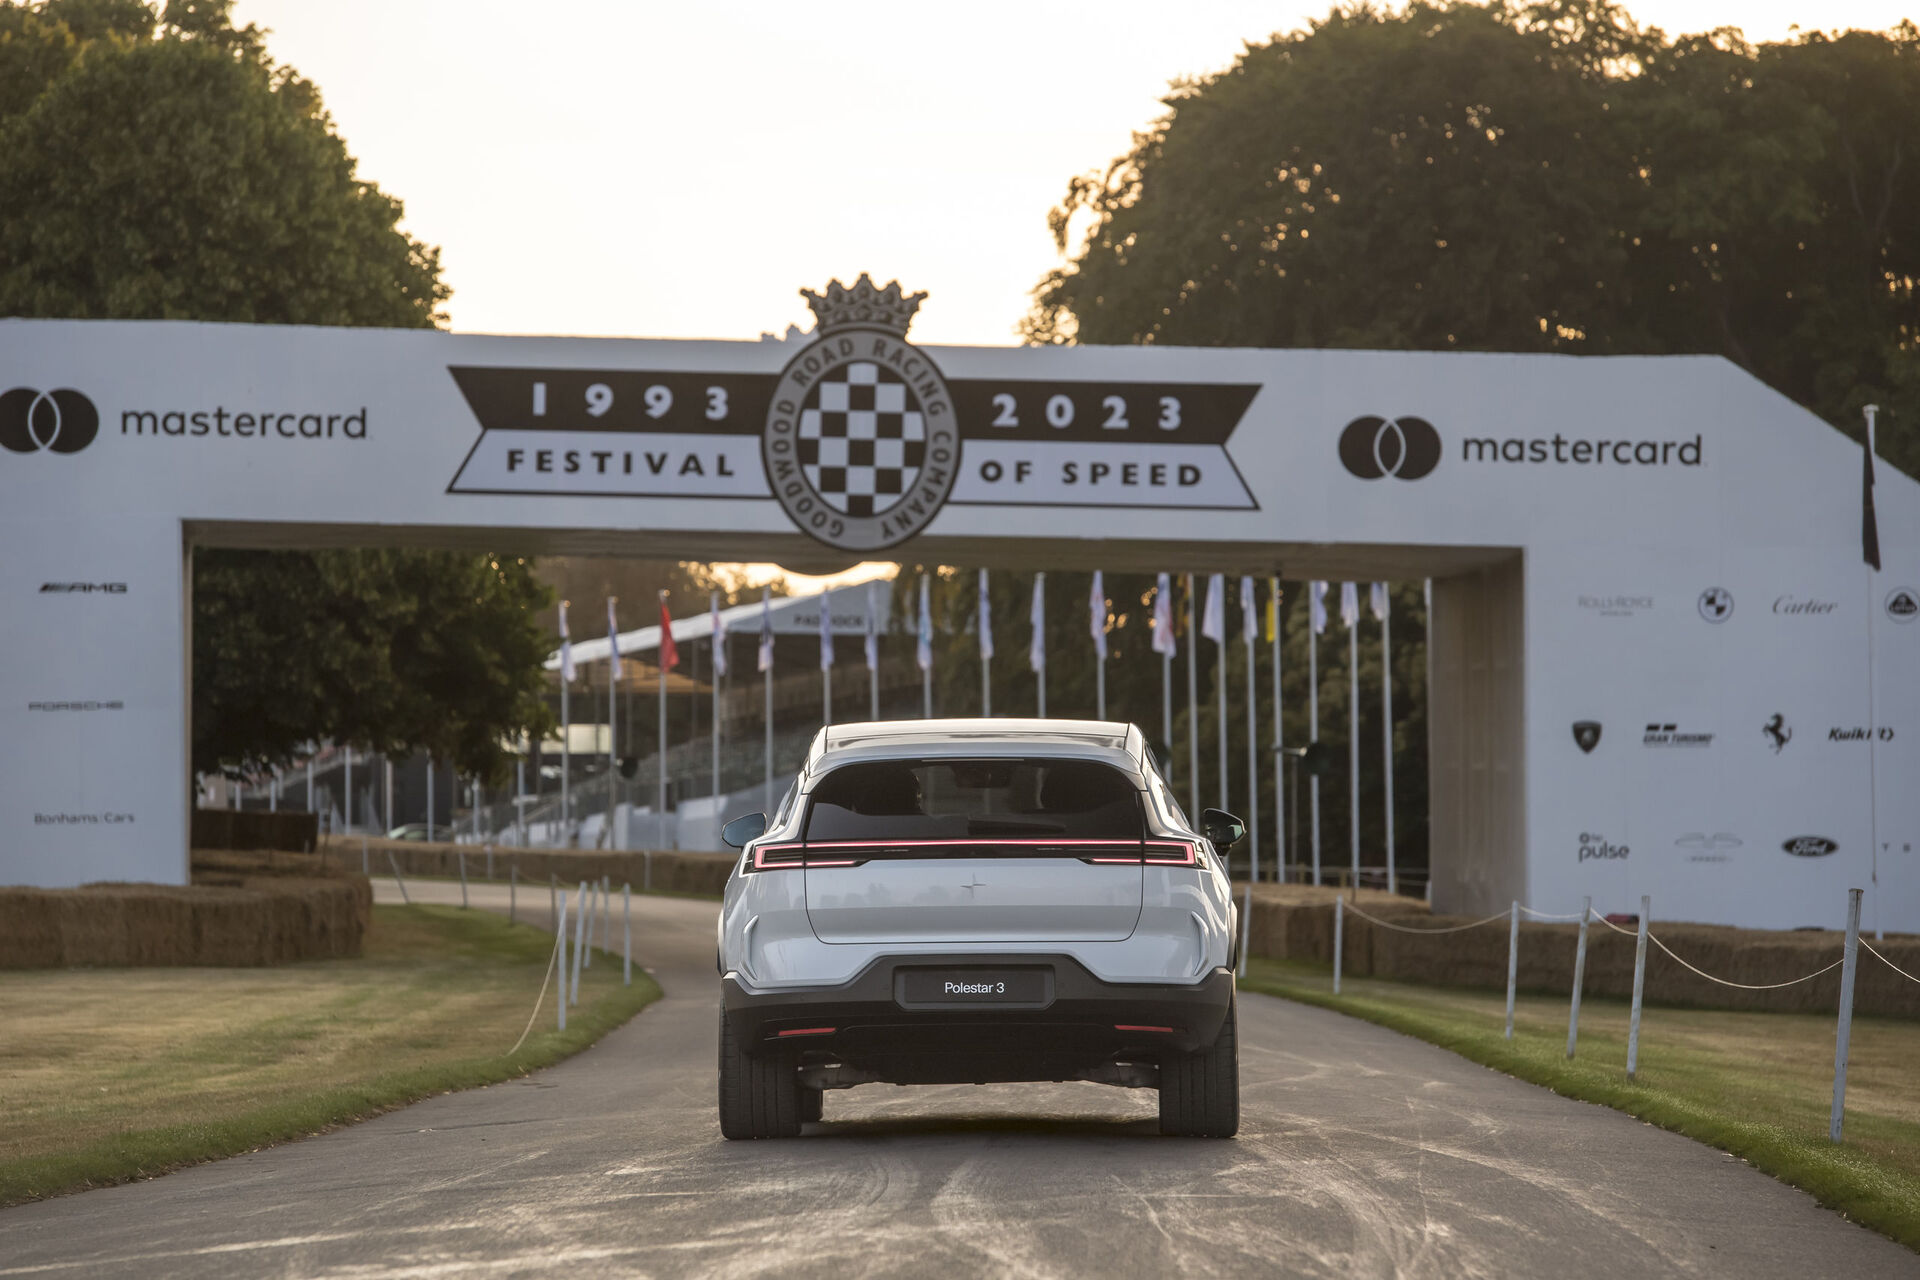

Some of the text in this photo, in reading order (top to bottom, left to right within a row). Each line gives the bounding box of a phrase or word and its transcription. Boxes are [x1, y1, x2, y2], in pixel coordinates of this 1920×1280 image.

[532, 382, 729, 420] 1993
[991, 393, 1182, 430] 2023
[121, 406, 368, 439] mastercard
[771, 338, 951, 541] GOODWOOD ROAD RACING COMPANY
[1462, 433, 1703, 467] mastercard
[507, 449, 735, 477] FESTIVAL
[979, 460, 1203, 487] OF SPEED
[1772, 597, 1838, 614] Cartier
[793, 614, 864, 627] PADOCK
[34, 812, 135, 825] Bonhams Cars
[1578, 844, 1630, 862] pulse
[944, 982, 1005, 994] Polestar 3
